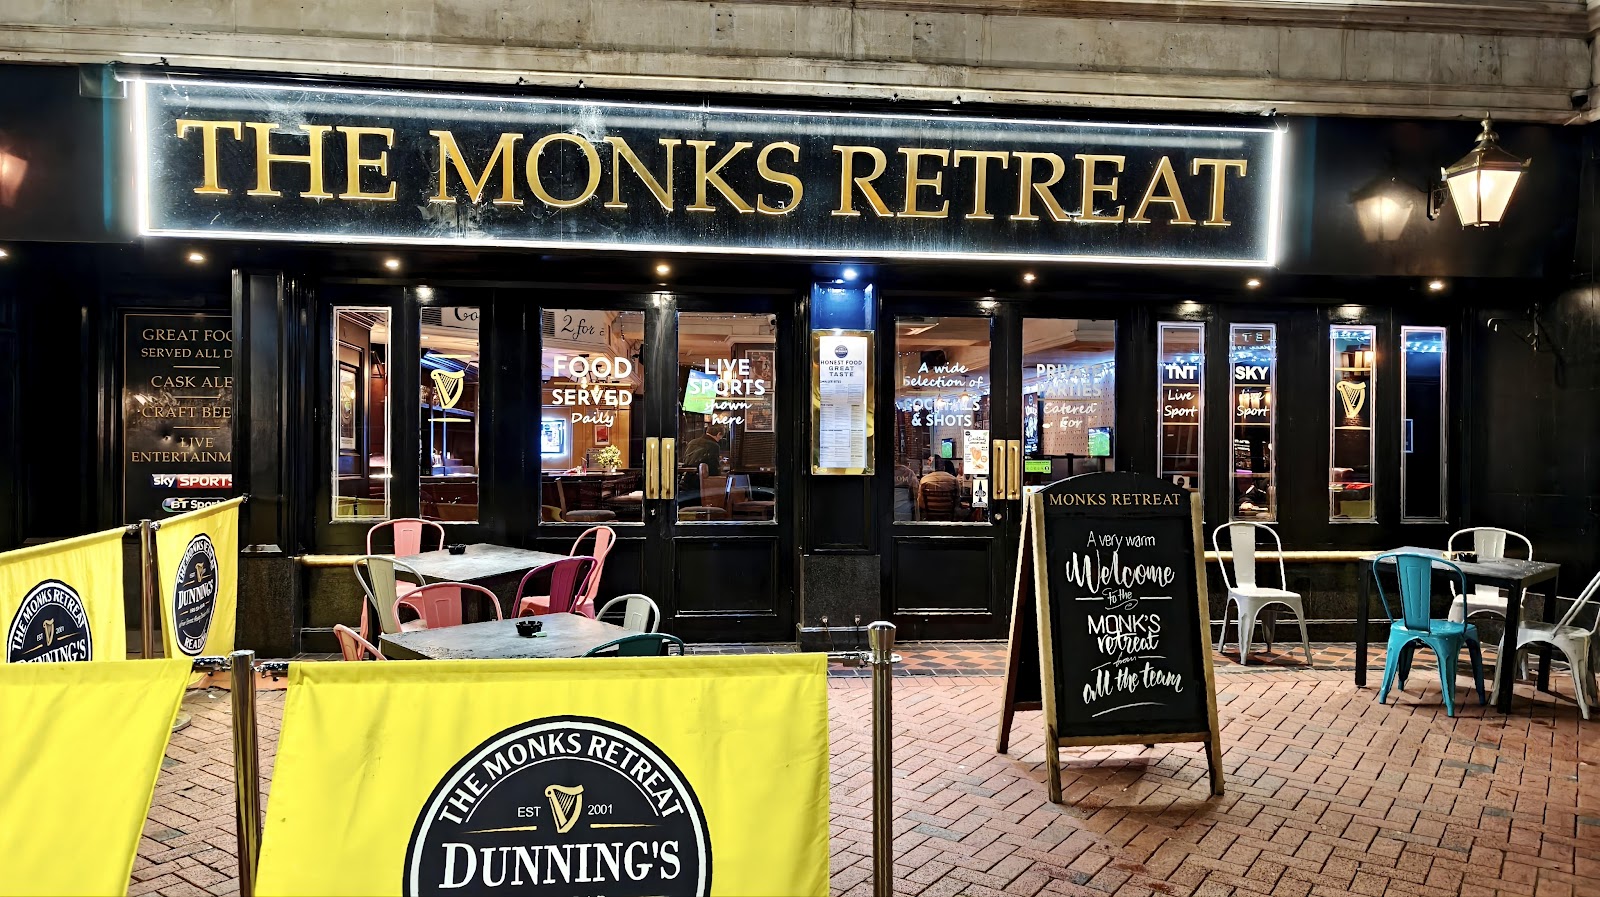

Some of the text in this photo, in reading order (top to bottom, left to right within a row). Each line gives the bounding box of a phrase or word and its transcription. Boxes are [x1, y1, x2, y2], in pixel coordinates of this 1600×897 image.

[176, 118, 1247, 227] THE MONKS RETREAT
[561, 314, 574, 333] 2
[572, 318, 595, 340] for
[142, 328, 199, 341] GREAT
[141, 347, 192, 358] SERVED
[195, 349, 220, 358] ALL
[553, 356, 633, 379] FOOD
[704, 358, 750, 376] LIVE
[917, 361, 969, 374] A wide
[1036, 363, 1102, 379] PRIVATE
[1165, 365, 1197, 380] TNT
[1235, 366, 1269, 380] SKY
[151, 375, 196, 388] CASK
[689, 379, 766, 396] SPORTS
[903, 375, 984, 388] Selection of
[1037, 382, 1102, 397] PARTIES
[1167, 389, 1195, 401] Live
[551, 389, 633, 406] SERVED
[142, 406, 197, 418] CRAFT
[704, 399, 753, 411] shown
[904, 398, 980, 412] COCKTAILS
[1043, 402, 1097, 415] Catered
[1164, 405, 1198, 419] Sport
[1236, 405, 1270, 419] Sport
[571, 412, 615, 428] Daily
[712, 413, 745, 426] here
[911, 413, 972, 427] & SHOTS
[1060, 416, 1083, 431] For
[181, 437, 214, 448] LIVE
[153, 475, 175, 487] sky
[170, 500, 189, 509] BT
[1050, 493, 1181, 506] MONKS RETREAT
[1086, 530, 1155, 550] A very warm
[1065, 549, 1175, 593] Welcome
[1117, 588, 1133, 600] the
[12, 588, 85, 651] THE MONKS RETREAT
[1087, 614, 1161, 635] MONK'S
[1097, 632, 1160, 655] retreat
[1083, 662, 1183, 704] all the team
[438, 732, 685, 826] THE MONKS RETREAT
[517, 804, 614, 818] EST 2001
[438, 840, 681, 889] DUNNING'S
